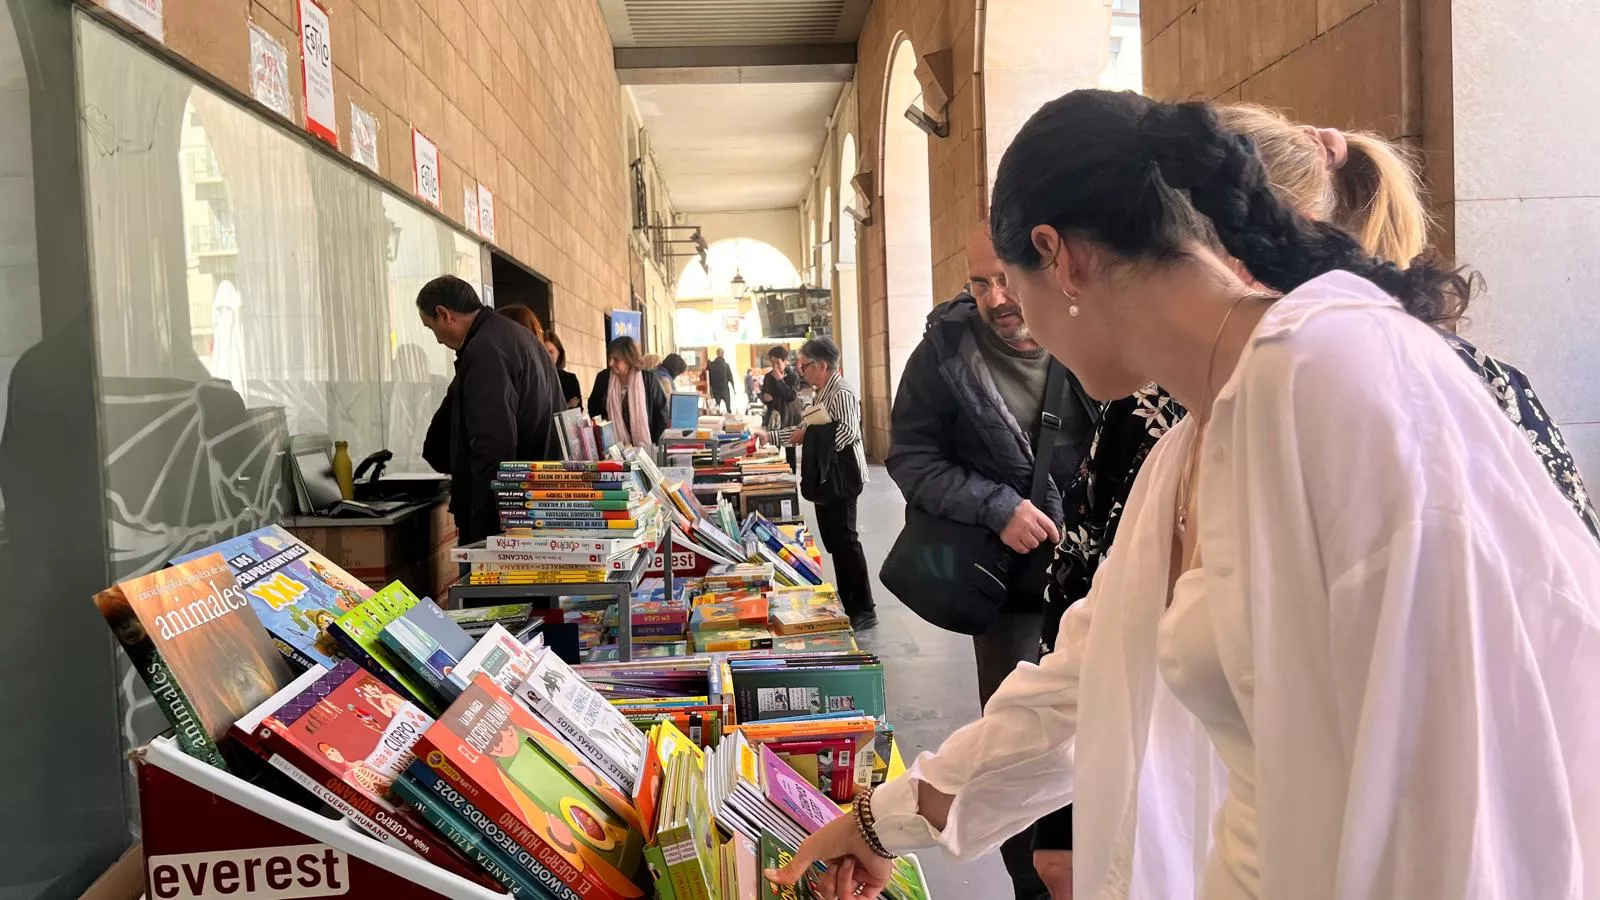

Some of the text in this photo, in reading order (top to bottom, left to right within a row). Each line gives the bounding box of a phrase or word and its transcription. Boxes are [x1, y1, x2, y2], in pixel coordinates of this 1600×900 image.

[231, 554, 254, 568] LOS
[236, 545, 306, 586] PERPREGUNTONES
[648, 554, 693, 568] eest
[154, 580, 247, 640] animales
[249, 573, 308, 611] XXL
[148, 662, 206, 748] animales
[483, 696, 514, 731] HUMANO
[384, 722, 416, 752] CUERPO
[458, 744, 480, 764] EL
[465, 717, 497, 754] CUERPO
[577, 736, 603, 760] CLIMAS
[608, 764, 634, 790] IMALES
[313, 785, 322, 796] EL
[324, 792, 354, 816] CUERPO
[354, 813, 389, 842] HUMANO
[328, 778, 376, 817] HUMANO
[376, 812, 408, 837] CUERPO
[433, 778, 562, 893] WORLD RECORDS 2025
[448, 828, 476, 850] AZUL
[500, 812, 592, 896] EL CUERPO HUMANO
[153, 849, 342, 898] everest
[476, 852, 522, 894] PLANETA
